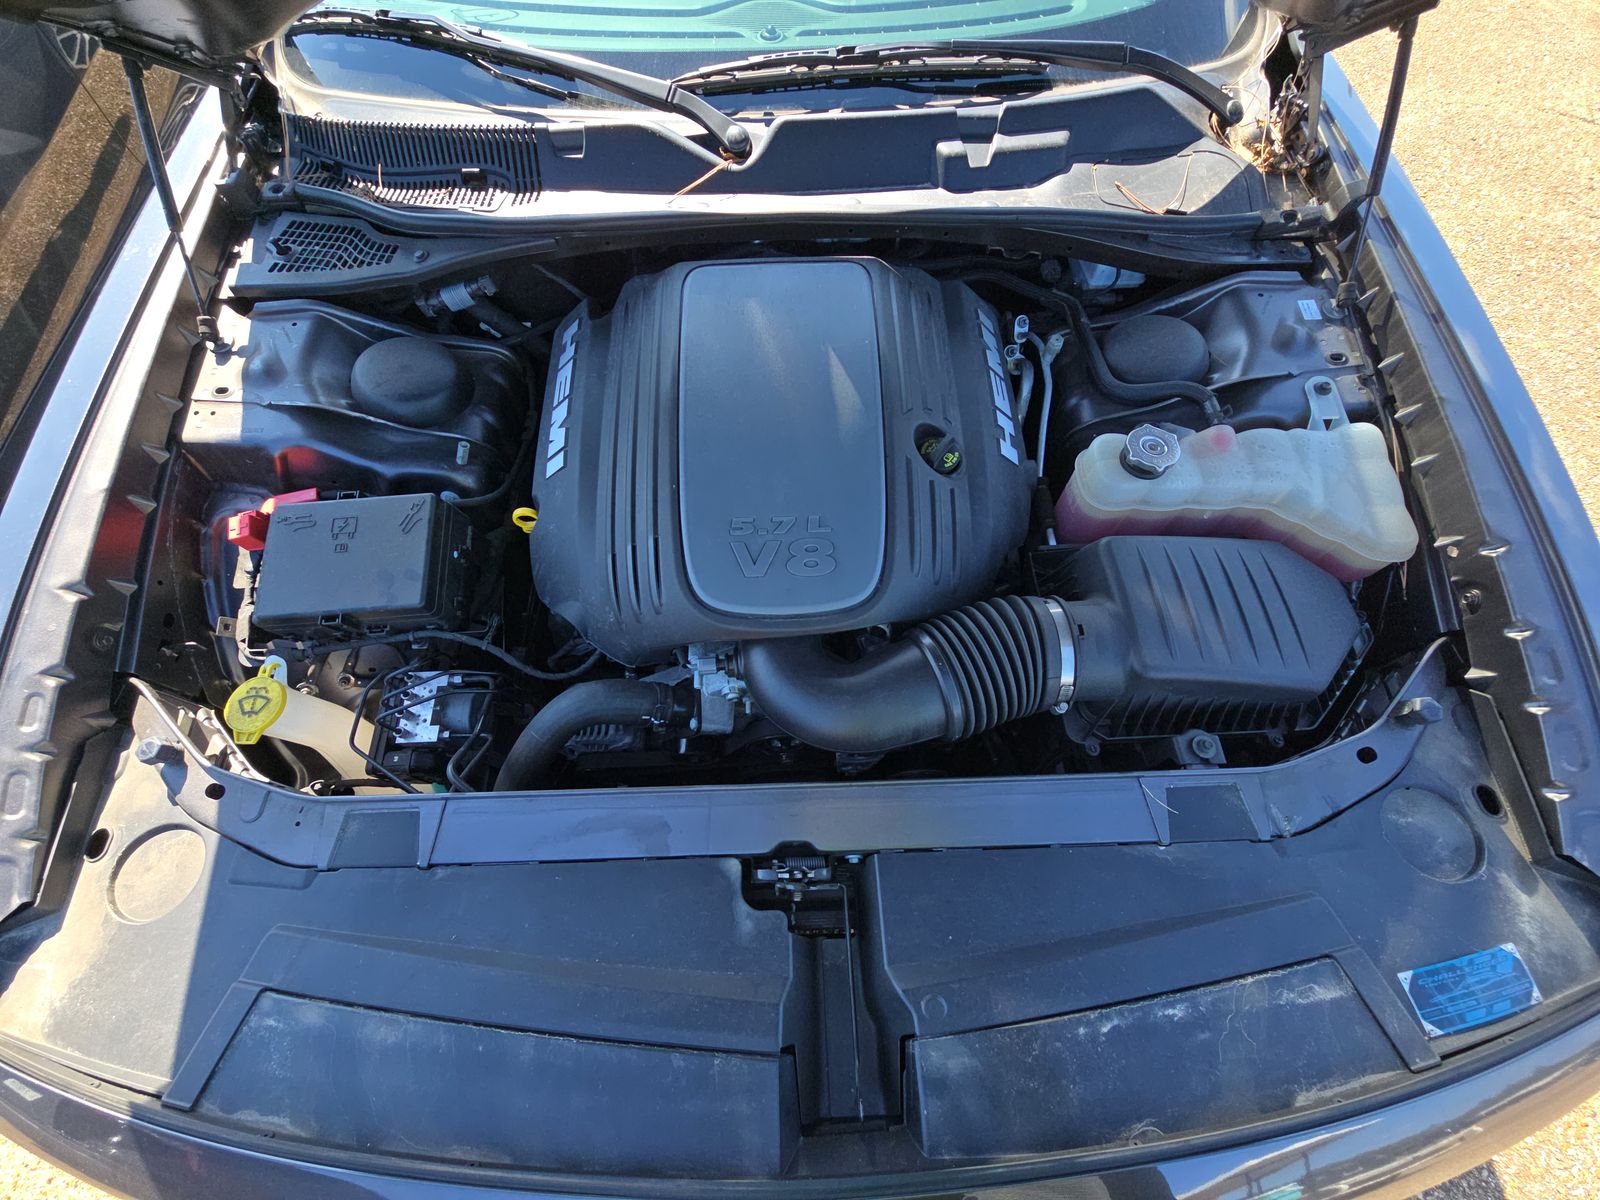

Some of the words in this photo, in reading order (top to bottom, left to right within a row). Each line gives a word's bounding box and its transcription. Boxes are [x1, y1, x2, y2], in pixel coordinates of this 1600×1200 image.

[545, 318, 580, 479] HEMI
[978, 308, 1020, 466] HEMI
[729, 537, 838, 578] V8
